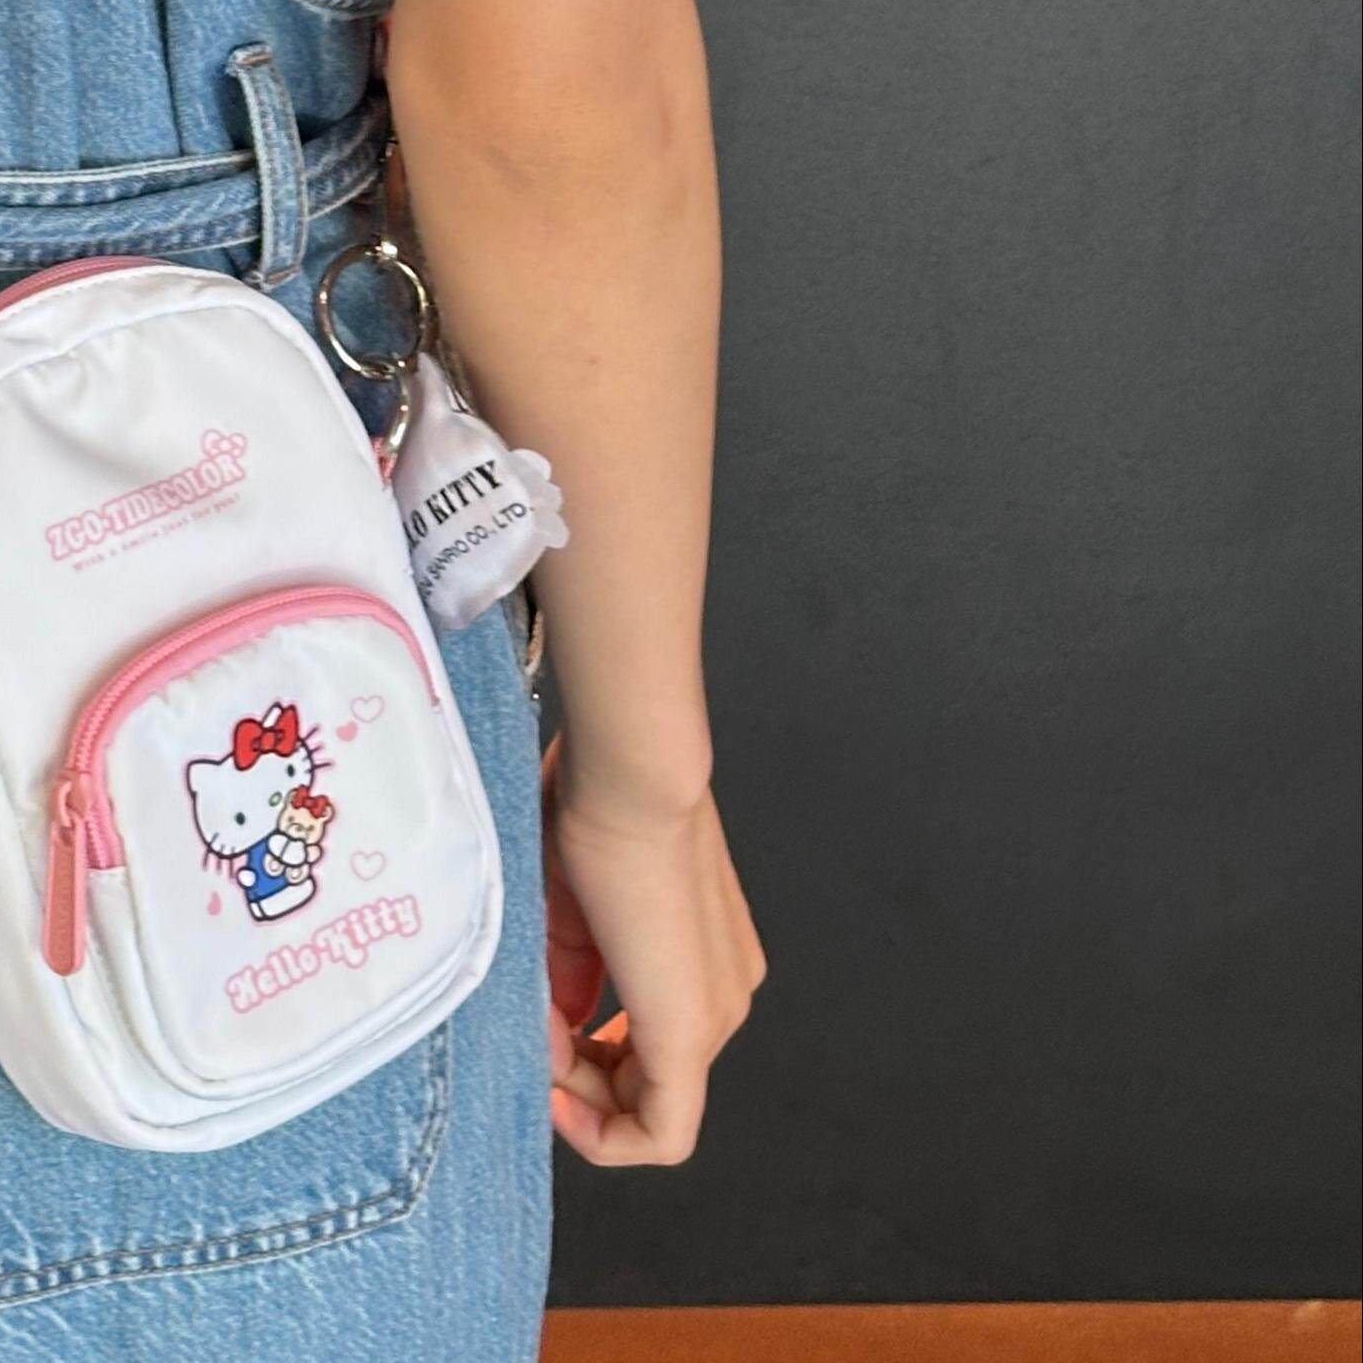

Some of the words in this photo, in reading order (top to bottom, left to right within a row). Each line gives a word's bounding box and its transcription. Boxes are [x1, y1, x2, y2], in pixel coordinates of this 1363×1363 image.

[426, 459, 503, 526] KITTY
[226, 945, 321, 1013] Hello
[313, 894, 421, 969] Kitty
